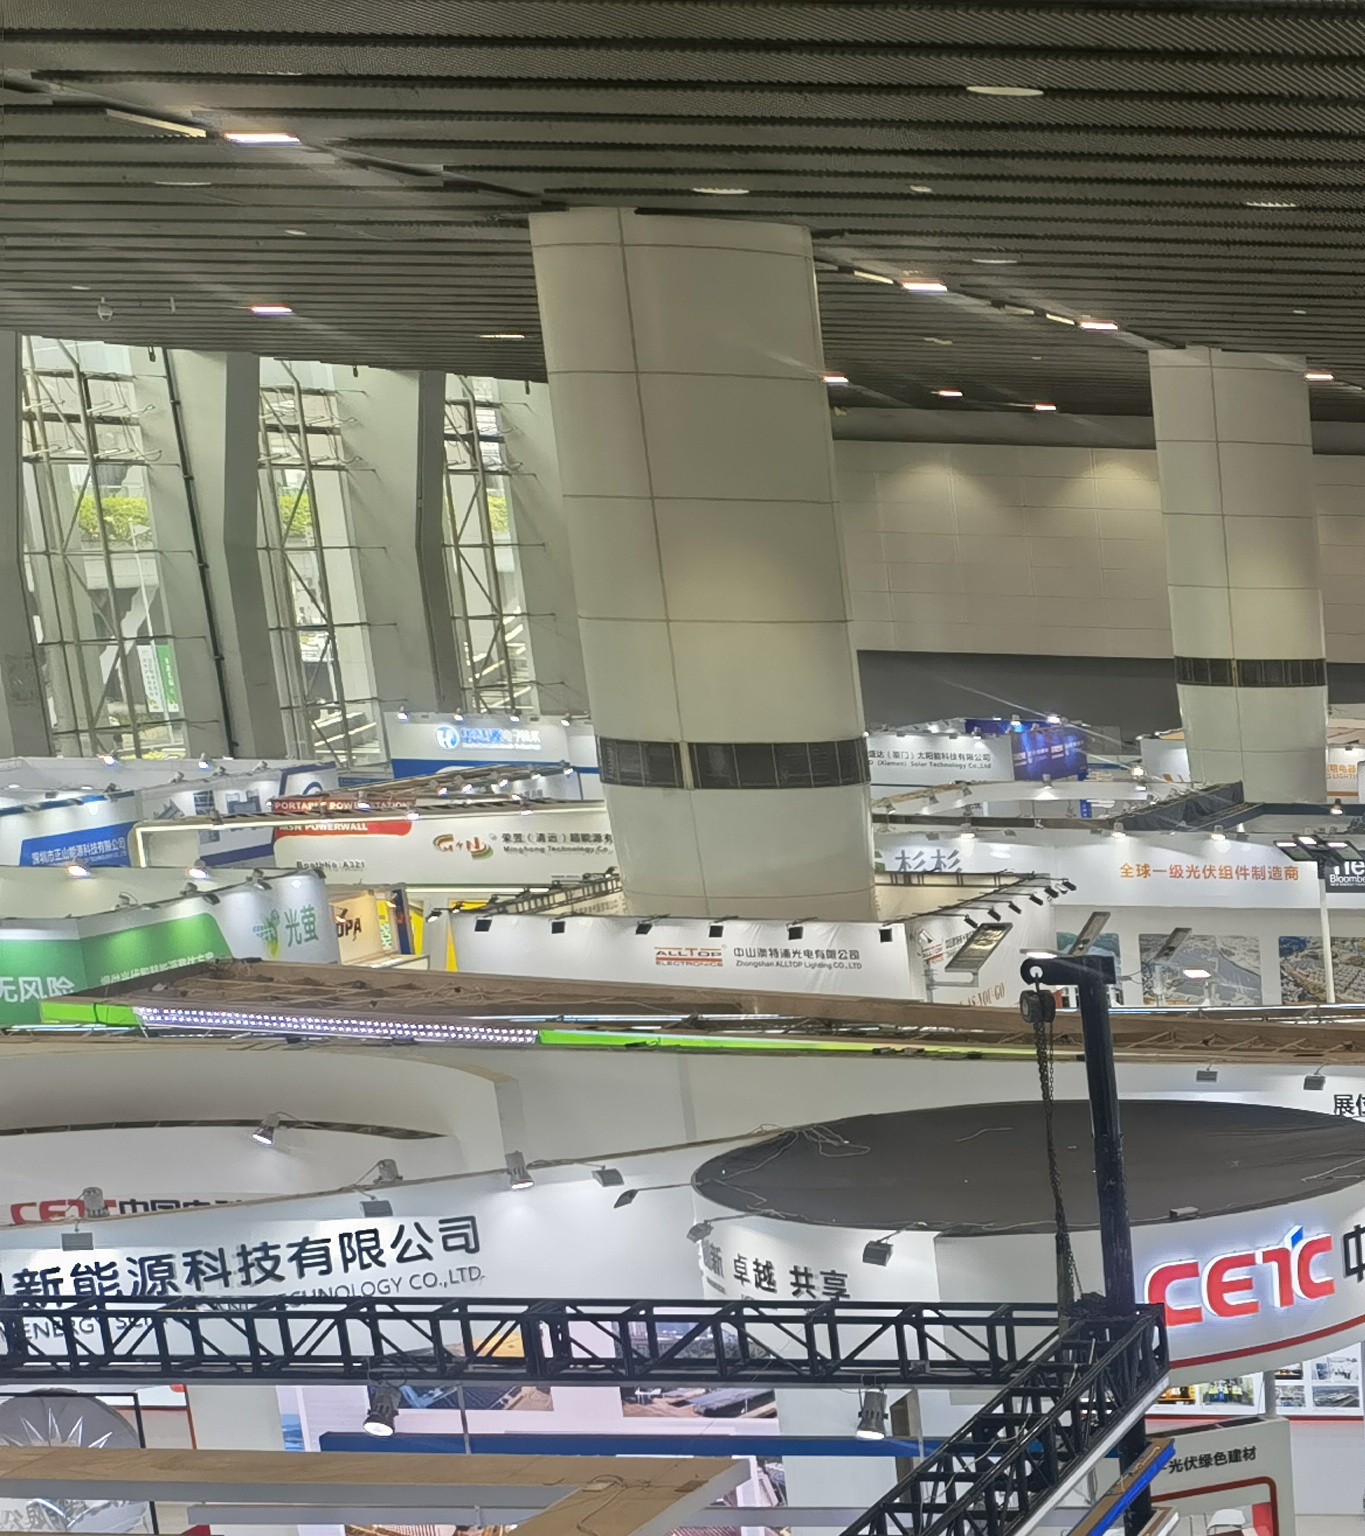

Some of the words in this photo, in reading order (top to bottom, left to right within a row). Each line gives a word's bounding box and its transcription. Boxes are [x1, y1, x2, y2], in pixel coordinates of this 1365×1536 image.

[1119, 863, 1300, 881] 全球一级光伏组件制造商
[1148, 1230, 1336, 1328] CETC
[1168, 1446, 1257, 1474] 光伏绿色建材
